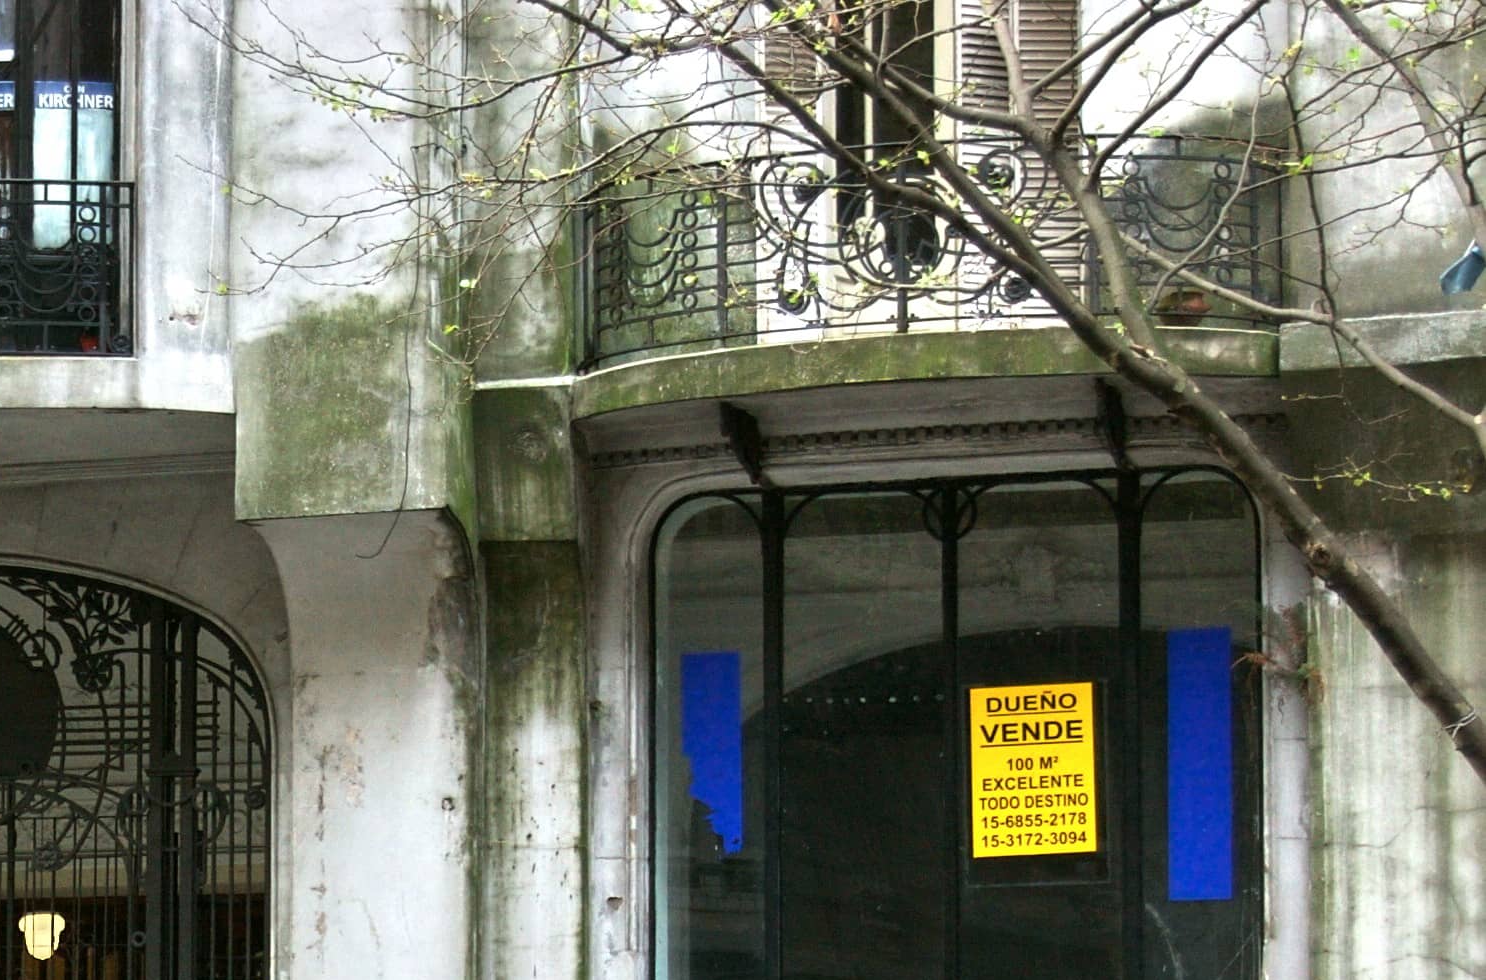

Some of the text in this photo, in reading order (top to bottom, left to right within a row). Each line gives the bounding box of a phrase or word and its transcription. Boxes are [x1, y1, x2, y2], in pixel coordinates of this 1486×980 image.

[986, 690, 1077, 713] DUEÑO
[980, 719, 1084, 743] VENDE
[1007, 758, 1033, 771] 100
[982, 774, 1084, 791] EXCELENTE
[979, 793, 1089, 811] TODO DESTINO
[982, 812, 1087, 829] 15-6855-2178
[982, 831, 1087, 848] 15-3172-3094
